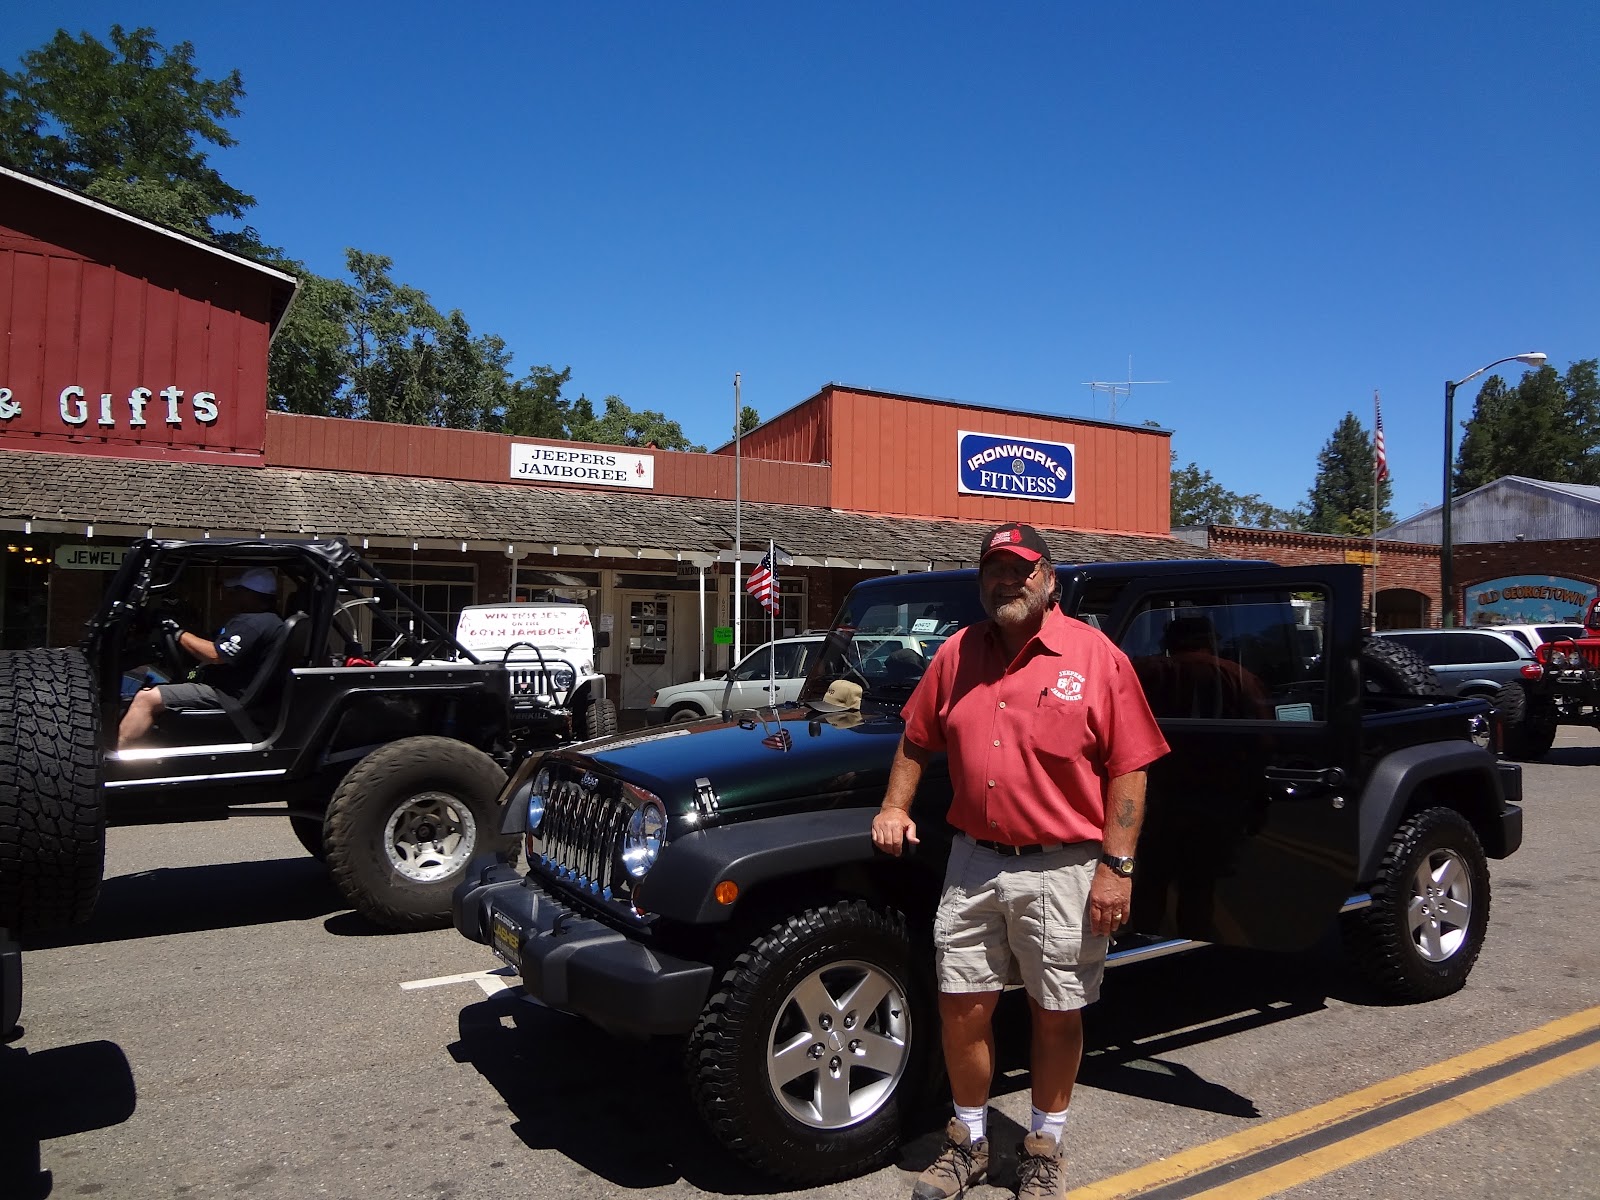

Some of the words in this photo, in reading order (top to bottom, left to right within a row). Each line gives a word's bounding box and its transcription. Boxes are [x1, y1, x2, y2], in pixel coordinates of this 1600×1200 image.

[0, 387, 22, 419] &
[59, 385, 219, 425] Gifts
[531, 448, 616, 467] JEEPERS
[967, 444, 1067, 481] IRONWORKS
[518, 462, 627, 482] JAMBOREE
[979, 469, 1056, 494] FITNESS
[678, 565, 712, 575] JAMBOEE
[1478, 590, 1499, 605] OLD
[1503, 586, 1587, 606] GEORGETOWN
